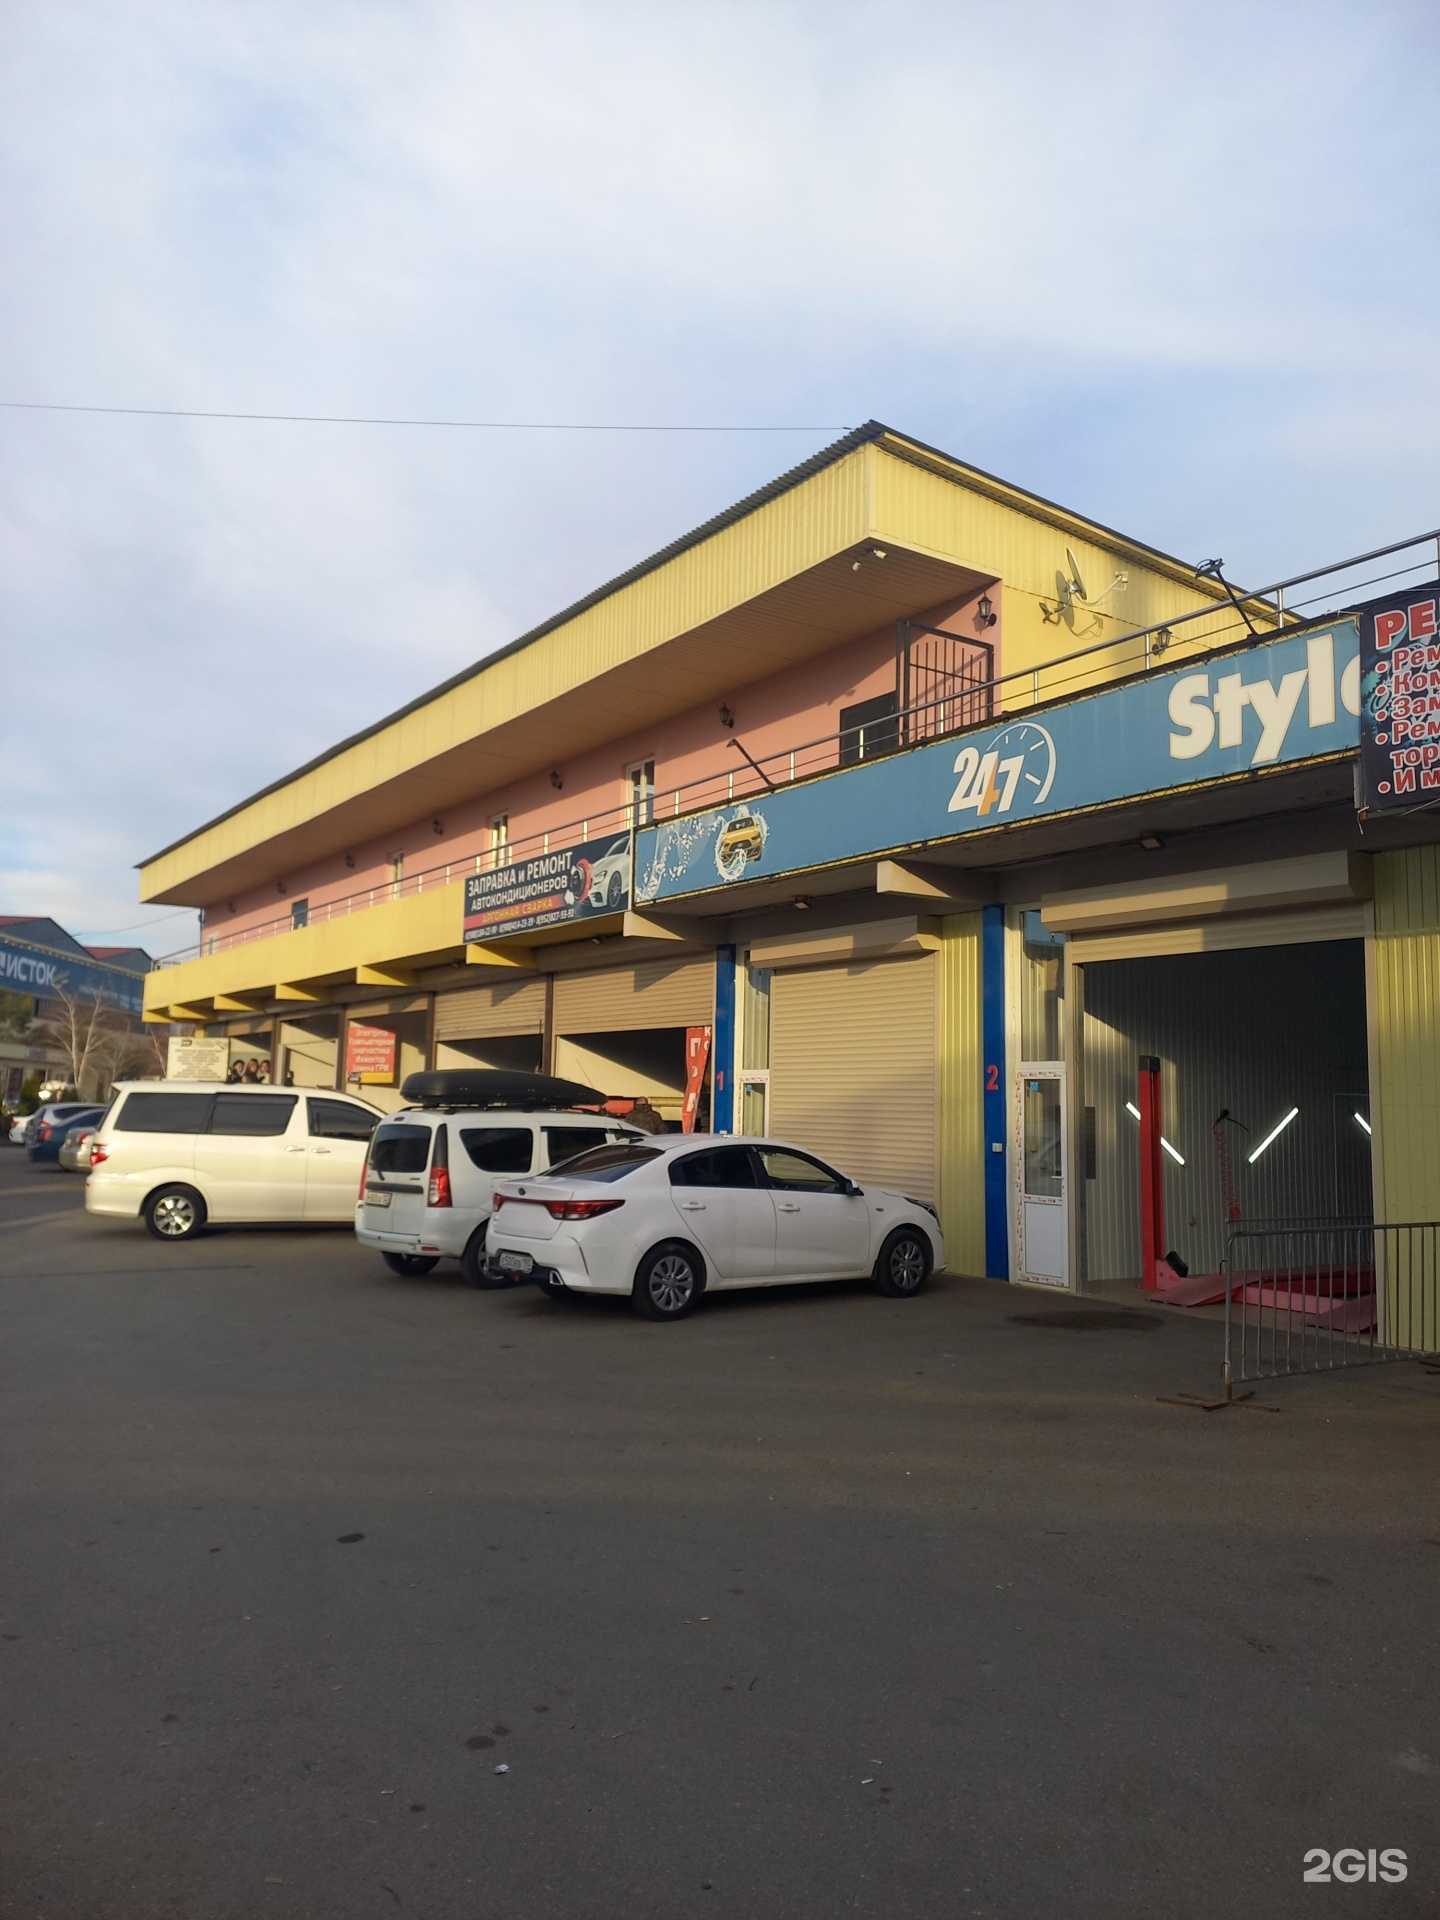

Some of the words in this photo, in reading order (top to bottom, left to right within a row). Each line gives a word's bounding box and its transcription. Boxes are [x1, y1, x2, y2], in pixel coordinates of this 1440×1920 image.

[1374, 597, 1440, 650] РЕ
[1393, 767, 1416, 794] И
[468, 868, 517, 897] ЗАПРАВКА
[518, 869, 526, 883] и
[527, 851, 573, 881] РЕМОНТ
[471, 875, 568, 912] АВТОКОНДИЦИОНЕРОВ
[716, 1071, 724, 1092] 1
[985, 1064, 999, 1092] 2
